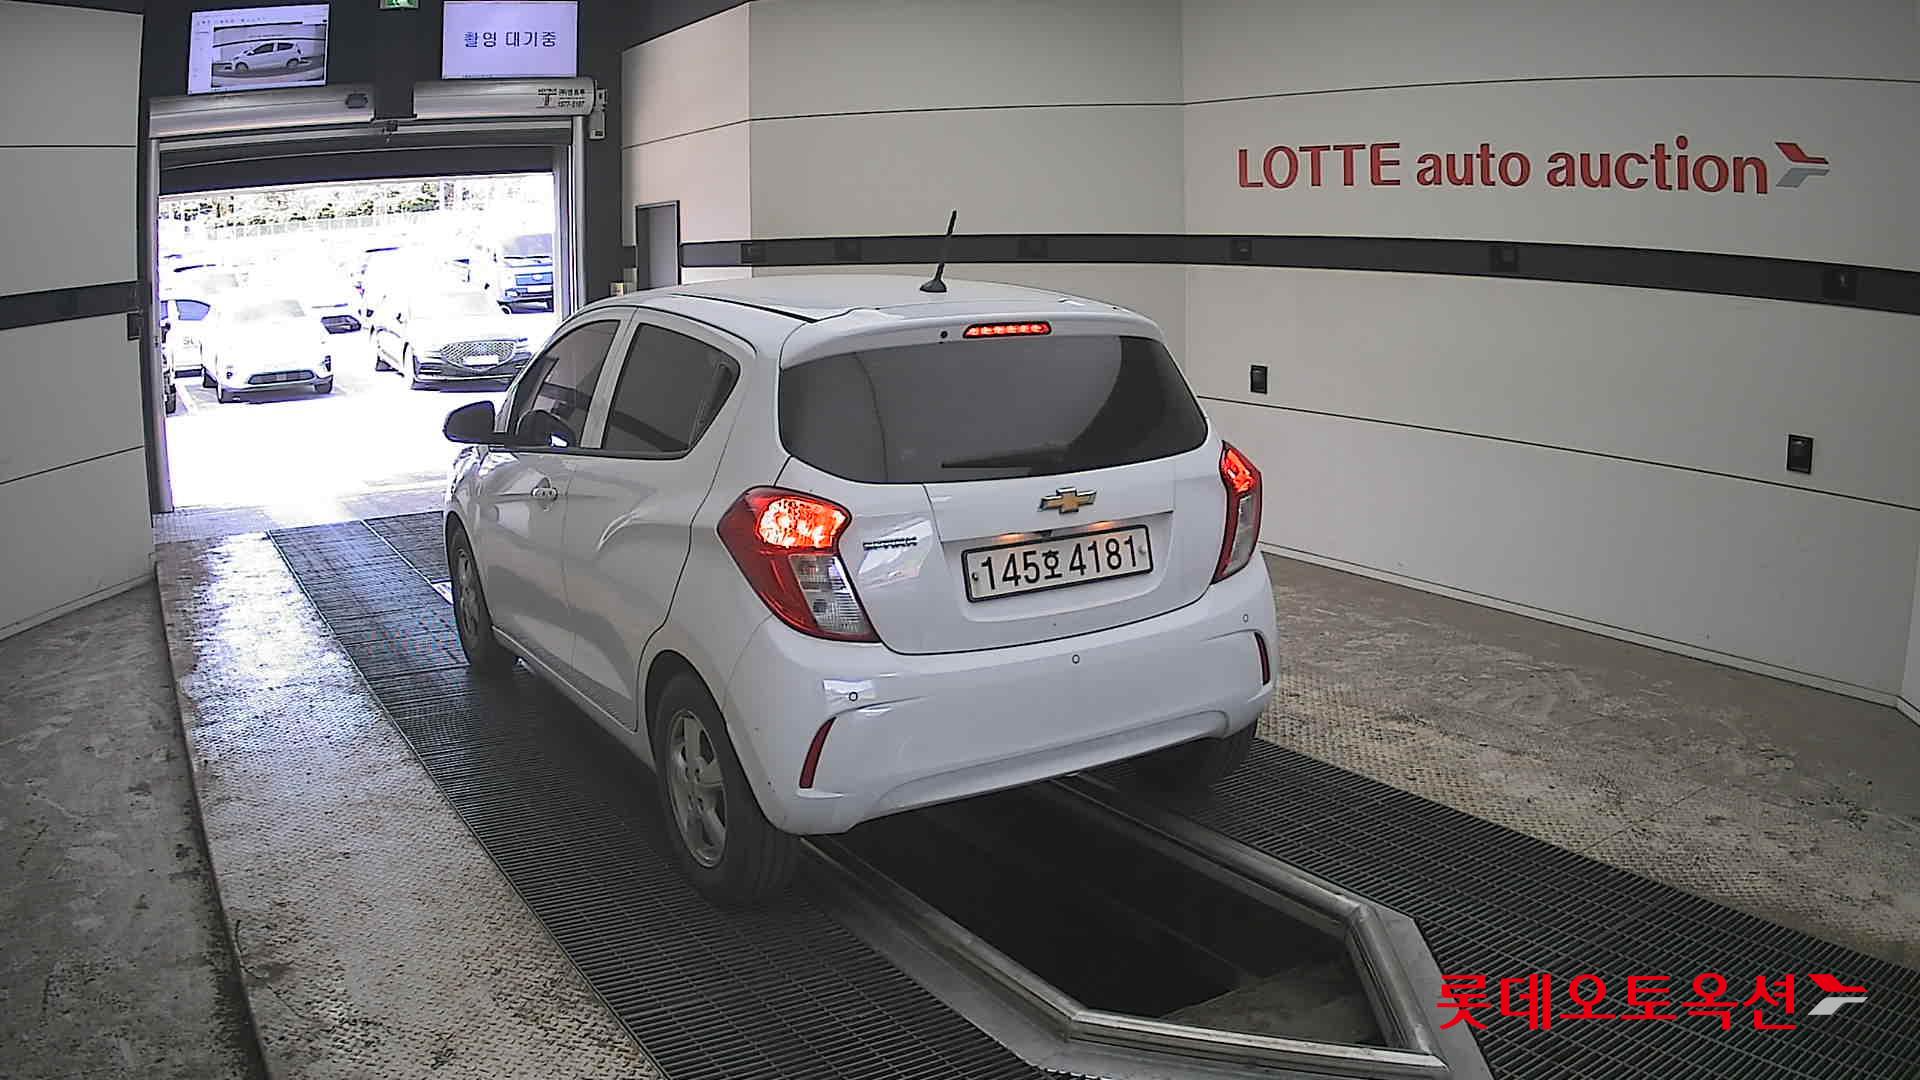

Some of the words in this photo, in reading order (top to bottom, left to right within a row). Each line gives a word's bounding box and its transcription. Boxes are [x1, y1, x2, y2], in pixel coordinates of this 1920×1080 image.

[504, 31, 557, 48] 대기중
[1237, 142, 1401, 190] LOTTE
[1415, 142, 1532, 188] auto
[1545, 134, 1769, 195] auction
